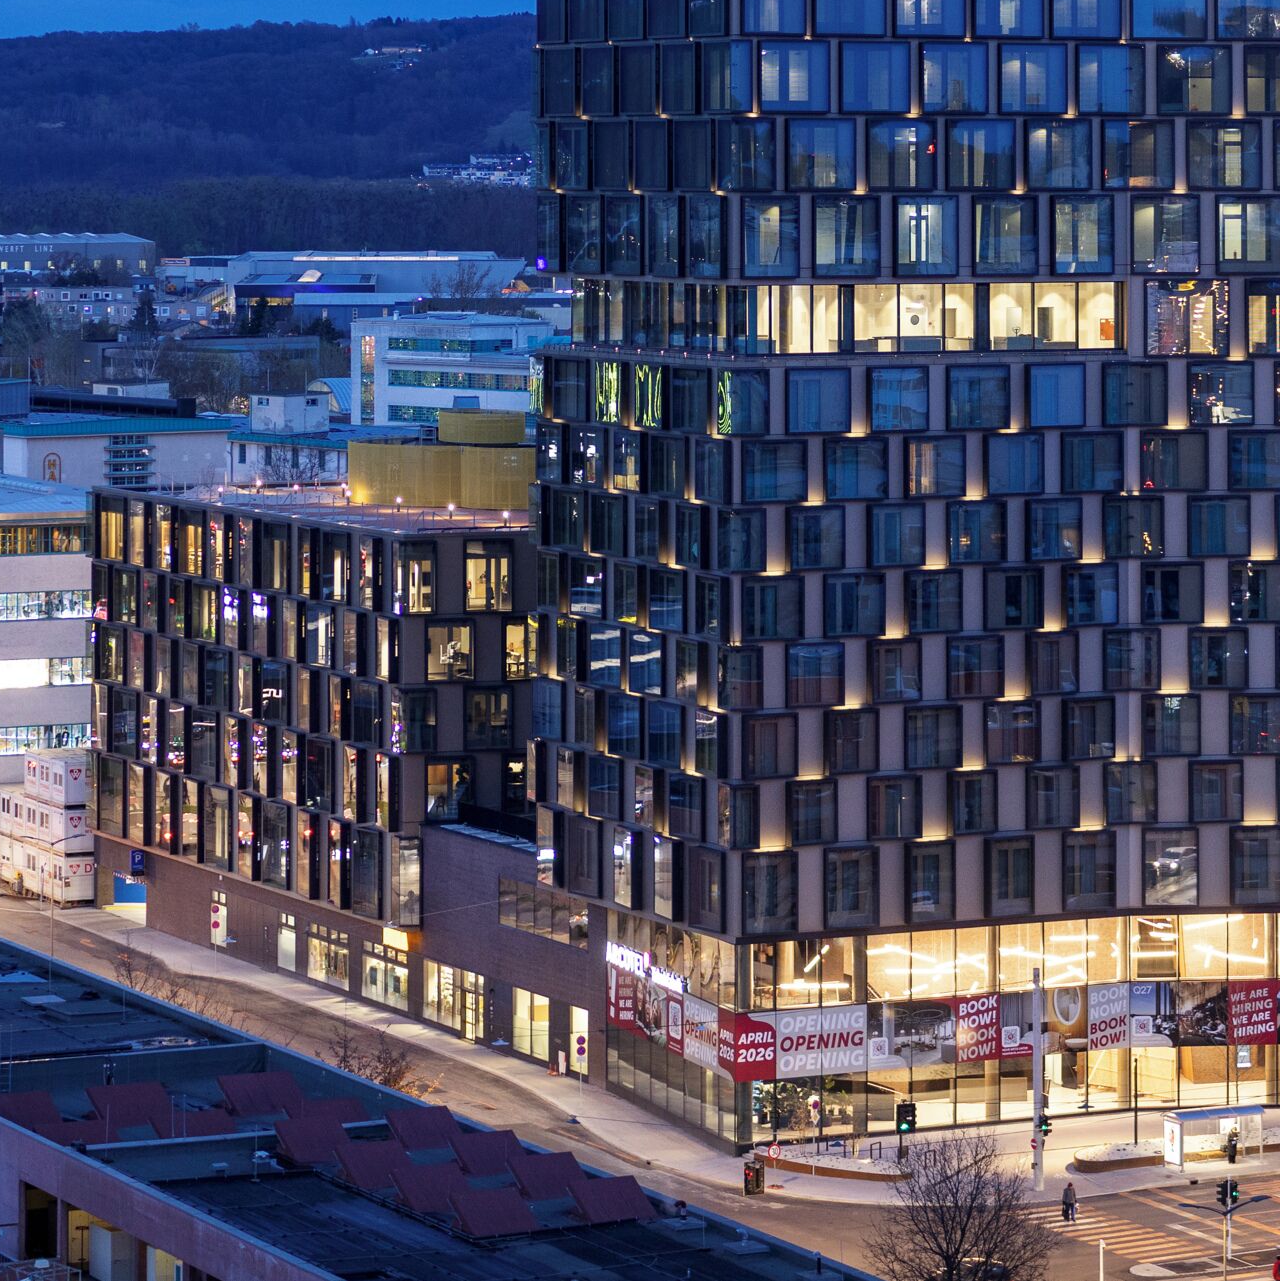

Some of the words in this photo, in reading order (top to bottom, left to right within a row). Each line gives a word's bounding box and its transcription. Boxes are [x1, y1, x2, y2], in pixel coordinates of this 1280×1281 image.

[135, 854, 142, 864] P
[1091, 985, 1128, 1005] BOOK
[1133, 986, 1152, 994] Q27
[1231, 992, 1247, 1002] WE
[1250, 987, 1269, 999] ARE
[685, 1000, 717, 1024] OPENING
[959, 995, 997, 1016] BOOK
[1090, 1000, 1127, 1020] NOW!
[1232, 999, 1273, 1015] HIRING
[780, 1011, 864, 1033] OPENING
[959, 1010, 996, 1030] NOW!
[1090, 1014, 1127, 1035] BOOK
[1232, 1015, 1249, 1025] WE
[1251, 1011, 1271, 1022] ARE
[685, 1020, 717, 1047] OPENING
[720, 1028, 734, 1044] APRIL
[738, 1031, 774, 1045] APRIL
[959, 1025, 996, 1046] BOOK
[1090, 1030, 1126, 1050] NOW!
[1234, 1022, 1275, 1038] HIRING
[780, 1030, 864, 1052] OPENING
[959, 1041, 996, 1061] NOW!
[685, 1040, 717, 1065] OPENING
[720, 1044, 734, 1062] 2026
[737, 1047, 774, 1063] 2026
[779, 1050, 864, 1071] OPENING
